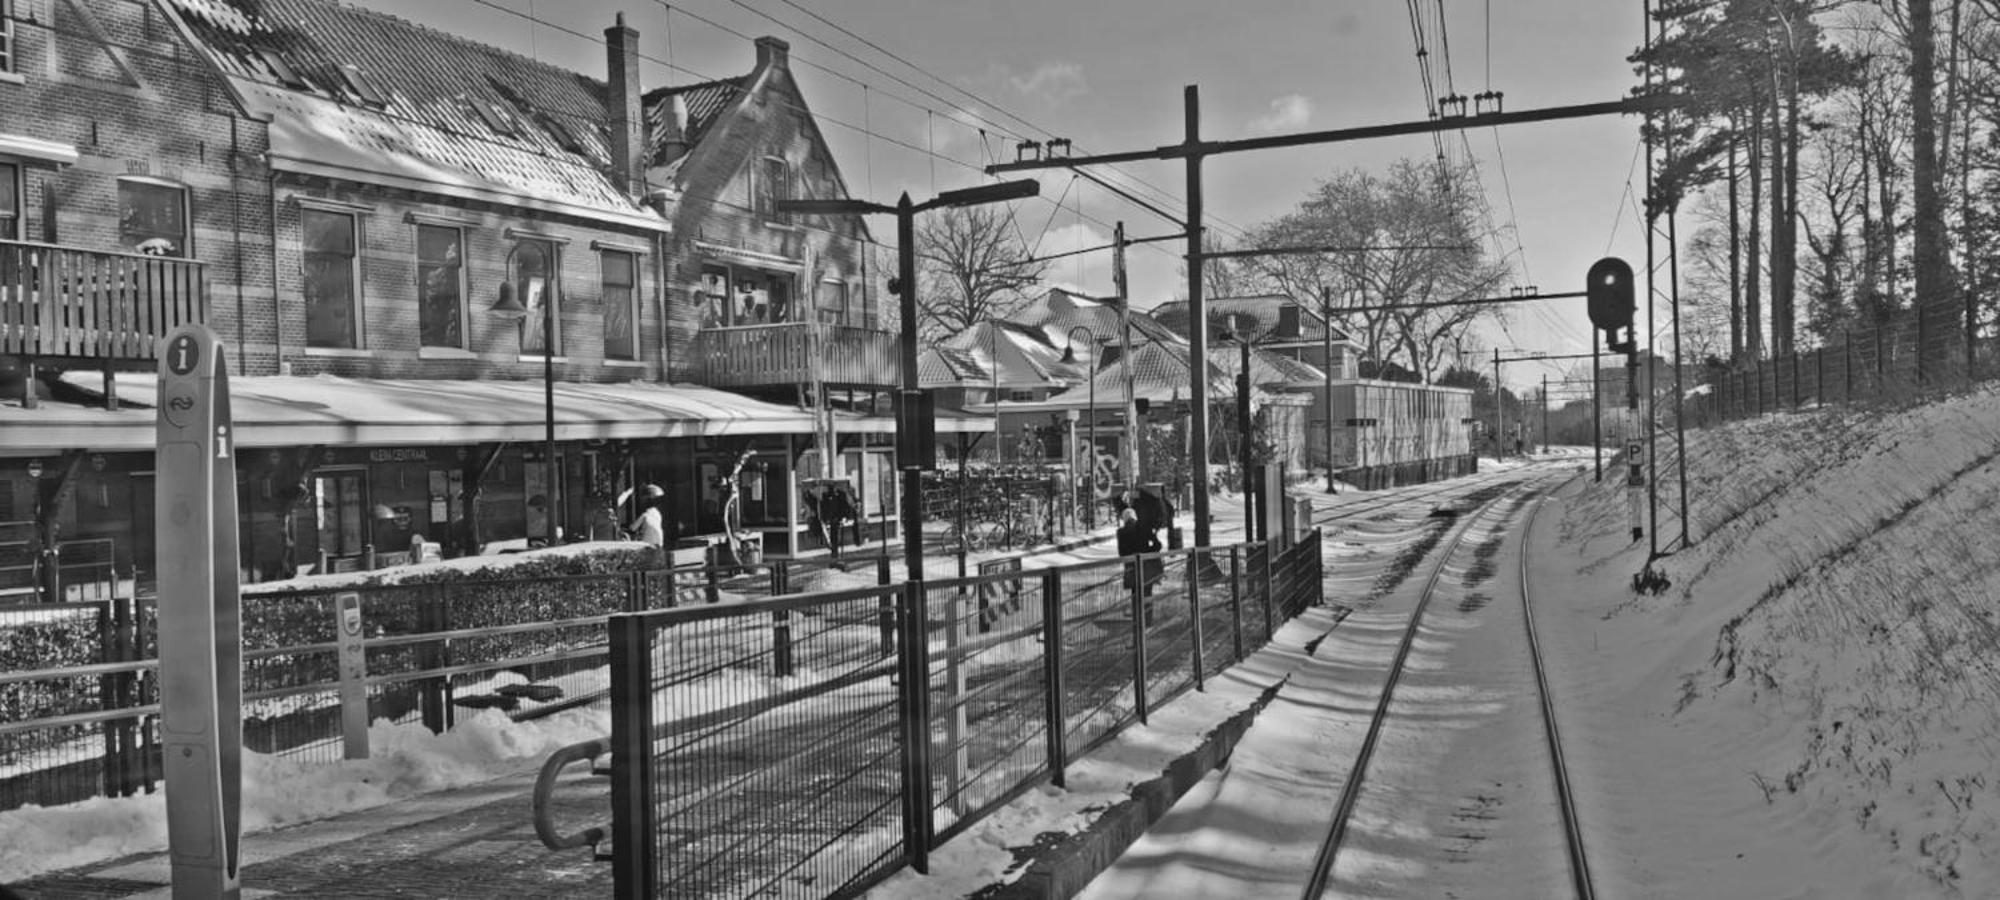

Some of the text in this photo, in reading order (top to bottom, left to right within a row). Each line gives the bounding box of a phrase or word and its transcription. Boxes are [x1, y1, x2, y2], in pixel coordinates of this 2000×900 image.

[177, 338, 188, 370] i
[216, 425, 229, 458] i
[1630, 445, 1641, 460] P
